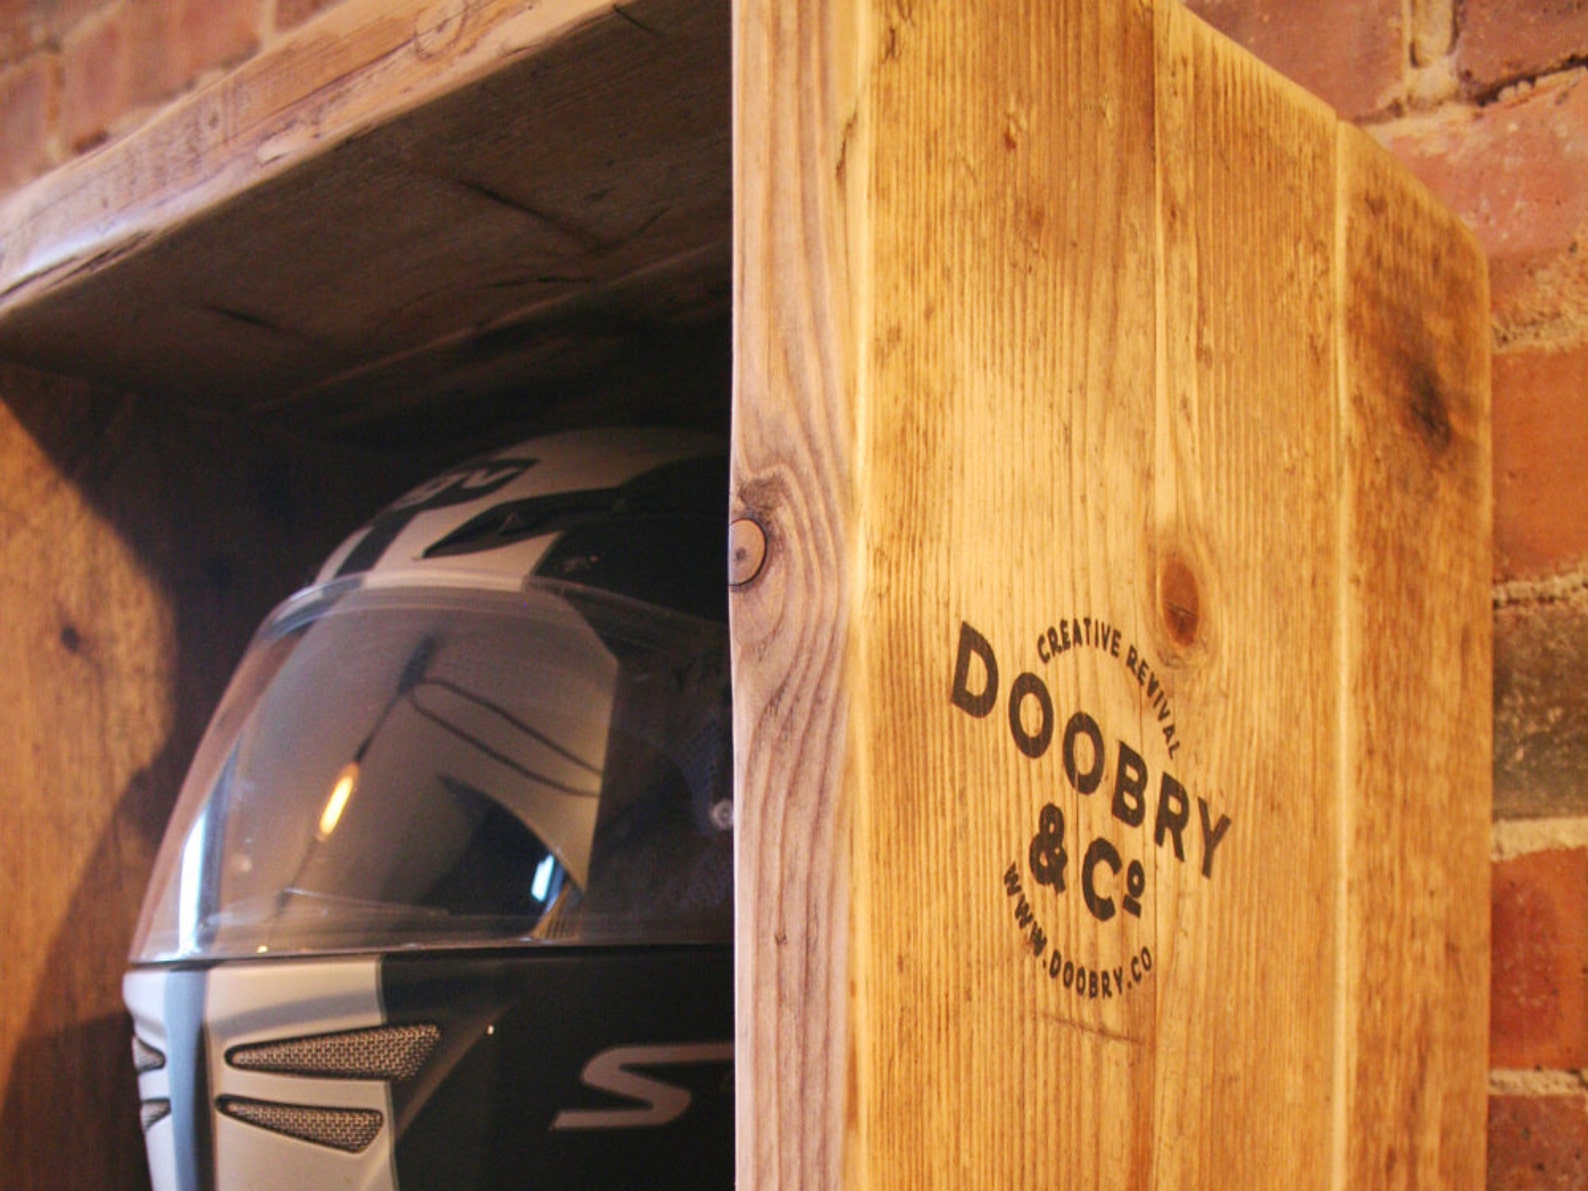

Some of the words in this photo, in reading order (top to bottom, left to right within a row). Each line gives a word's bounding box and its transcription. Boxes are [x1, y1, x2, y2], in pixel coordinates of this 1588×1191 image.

[951, 620, 1232, 879] DOOBRY
[1037, 617, 1122, 664] CREATIVE
[1126, 644, 1180, 760] REVIVAL
[1029, 803, 1068, 893] &
[1003, 861, 1152, 999] WWW.DOOBRY.CO
